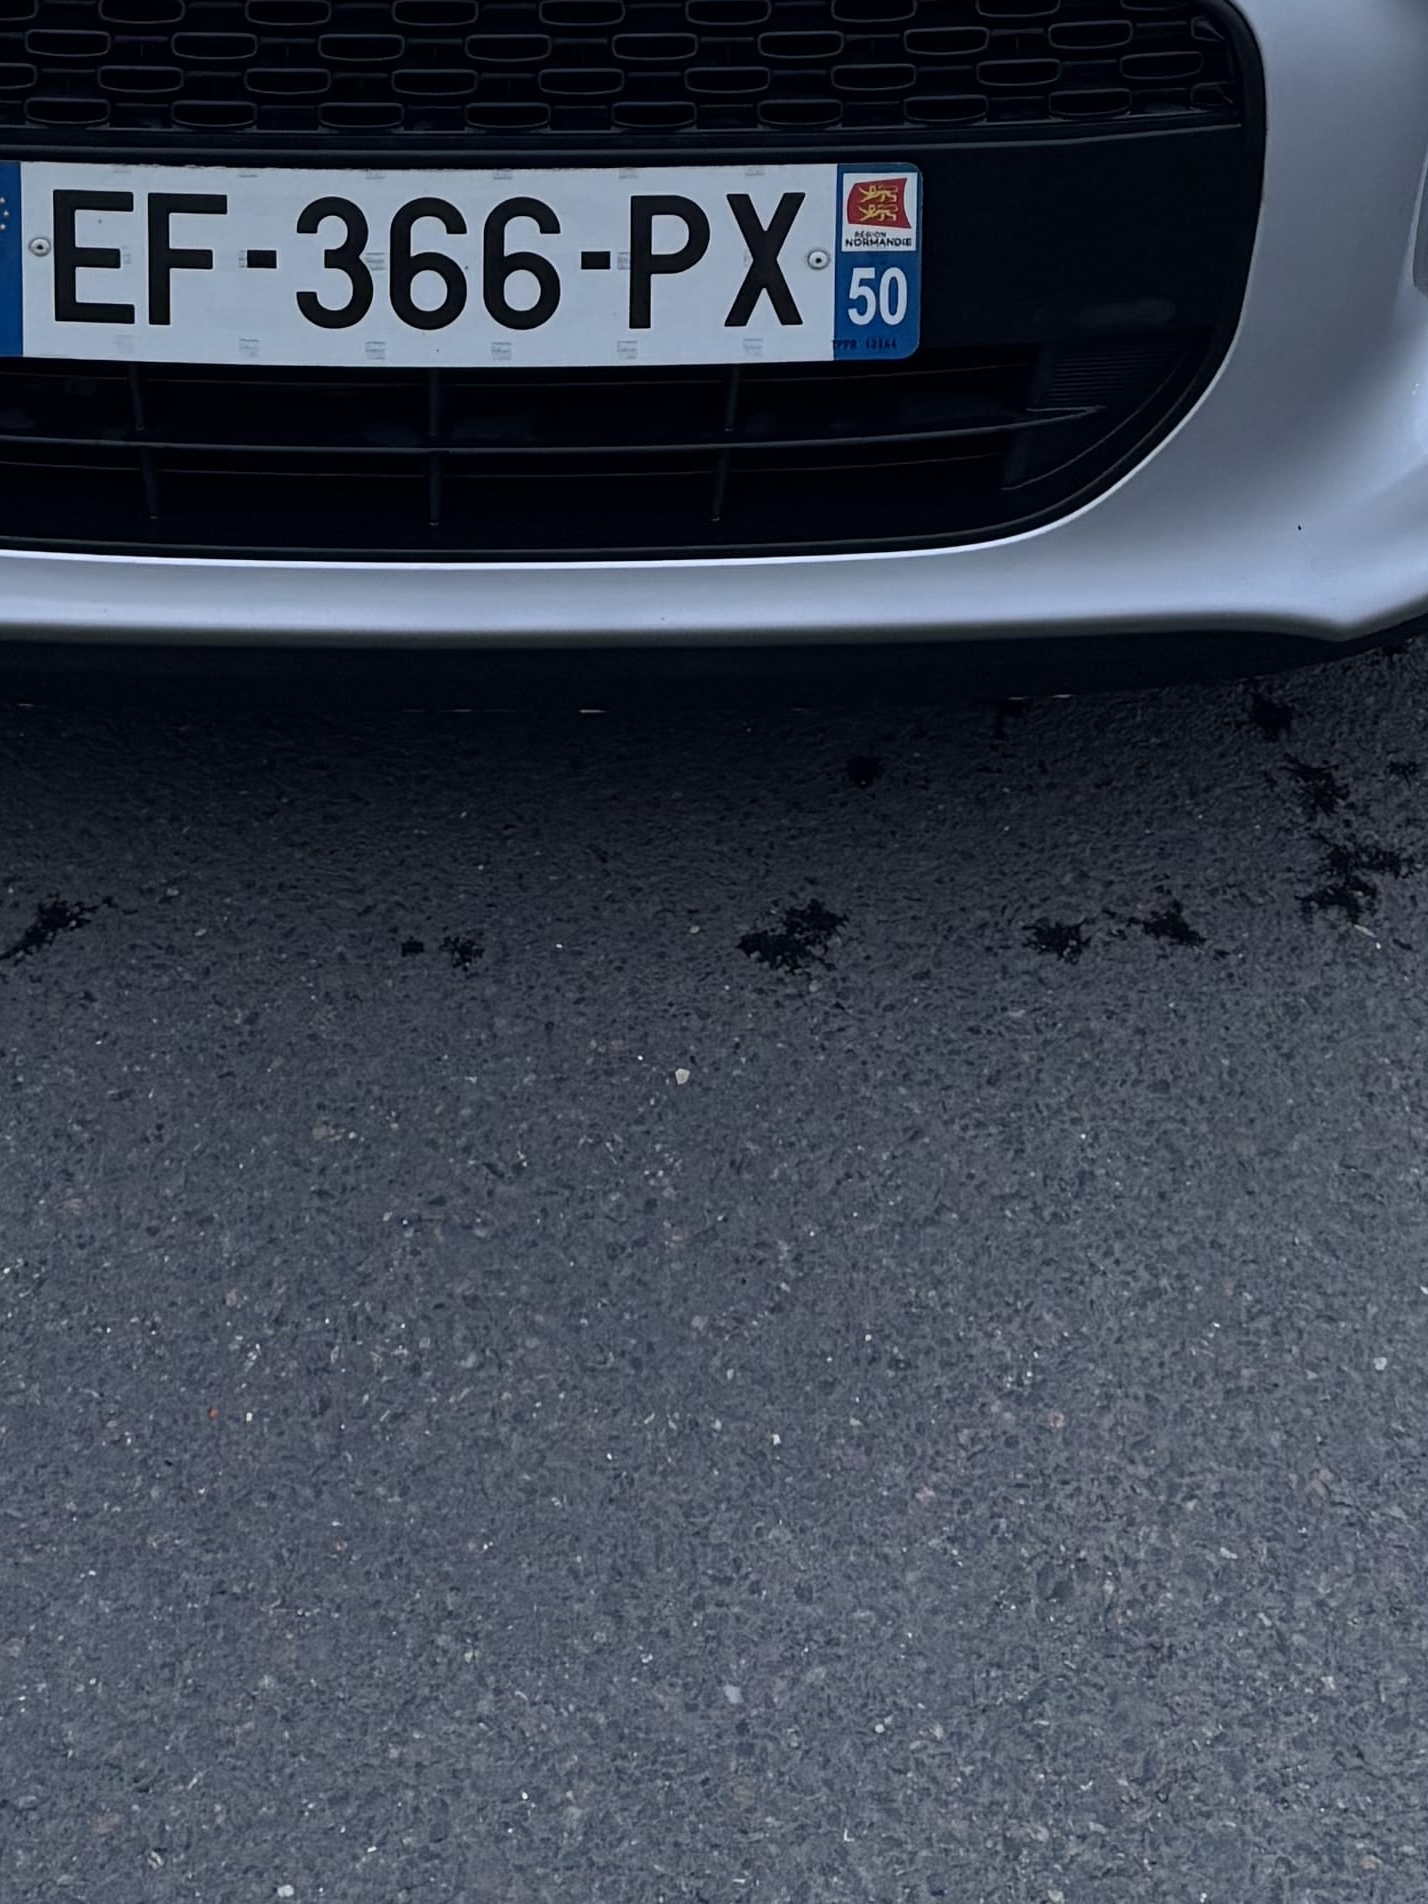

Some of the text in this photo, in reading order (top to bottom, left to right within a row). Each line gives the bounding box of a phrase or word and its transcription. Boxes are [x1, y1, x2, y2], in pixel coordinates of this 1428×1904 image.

[52, 188, 807, 331] EF-366-PX
[845, 237, 912, 248] NORMANDIE
[847, 266, 908, 326] 50
